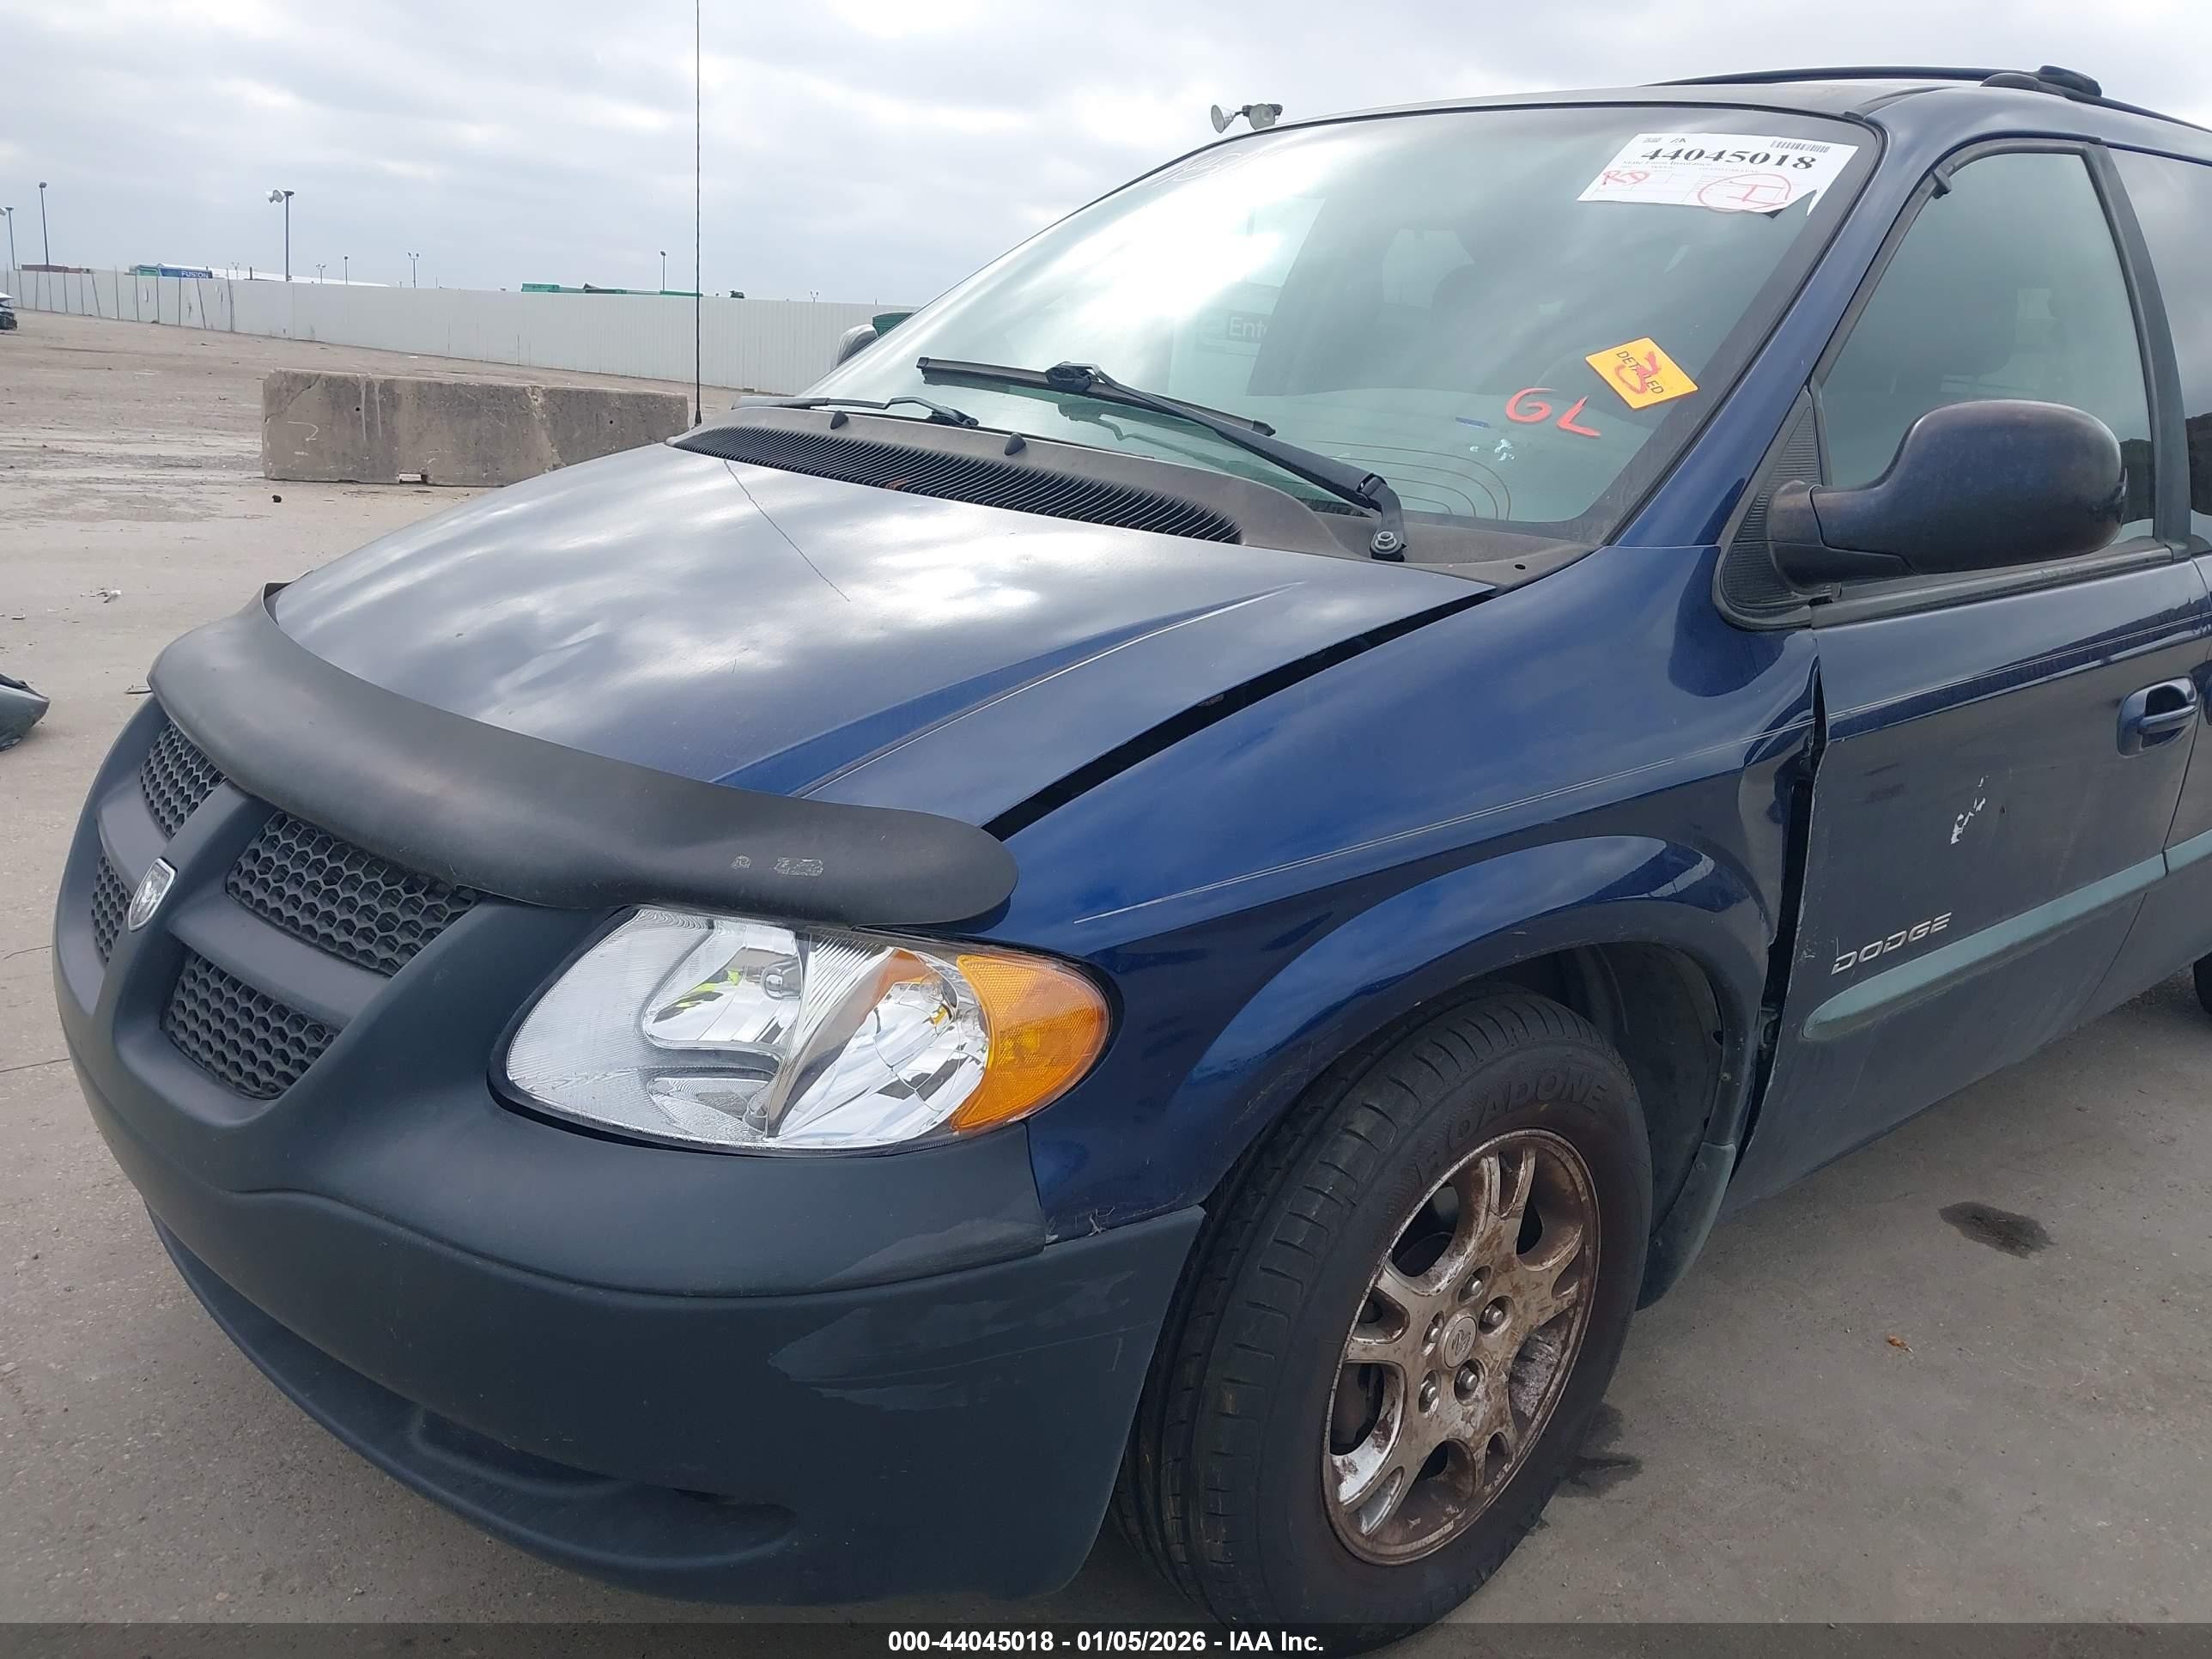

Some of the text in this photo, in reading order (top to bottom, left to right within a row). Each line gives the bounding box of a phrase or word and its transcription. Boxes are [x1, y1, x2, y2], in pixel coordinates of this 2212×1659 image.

[1641, 148, 1817, 170] 44045018
[181, 270, 209, 279] FUSION
[1616, 350, 1664, 395] DETALED
[1830, 912, 1952, 975] DODGE
